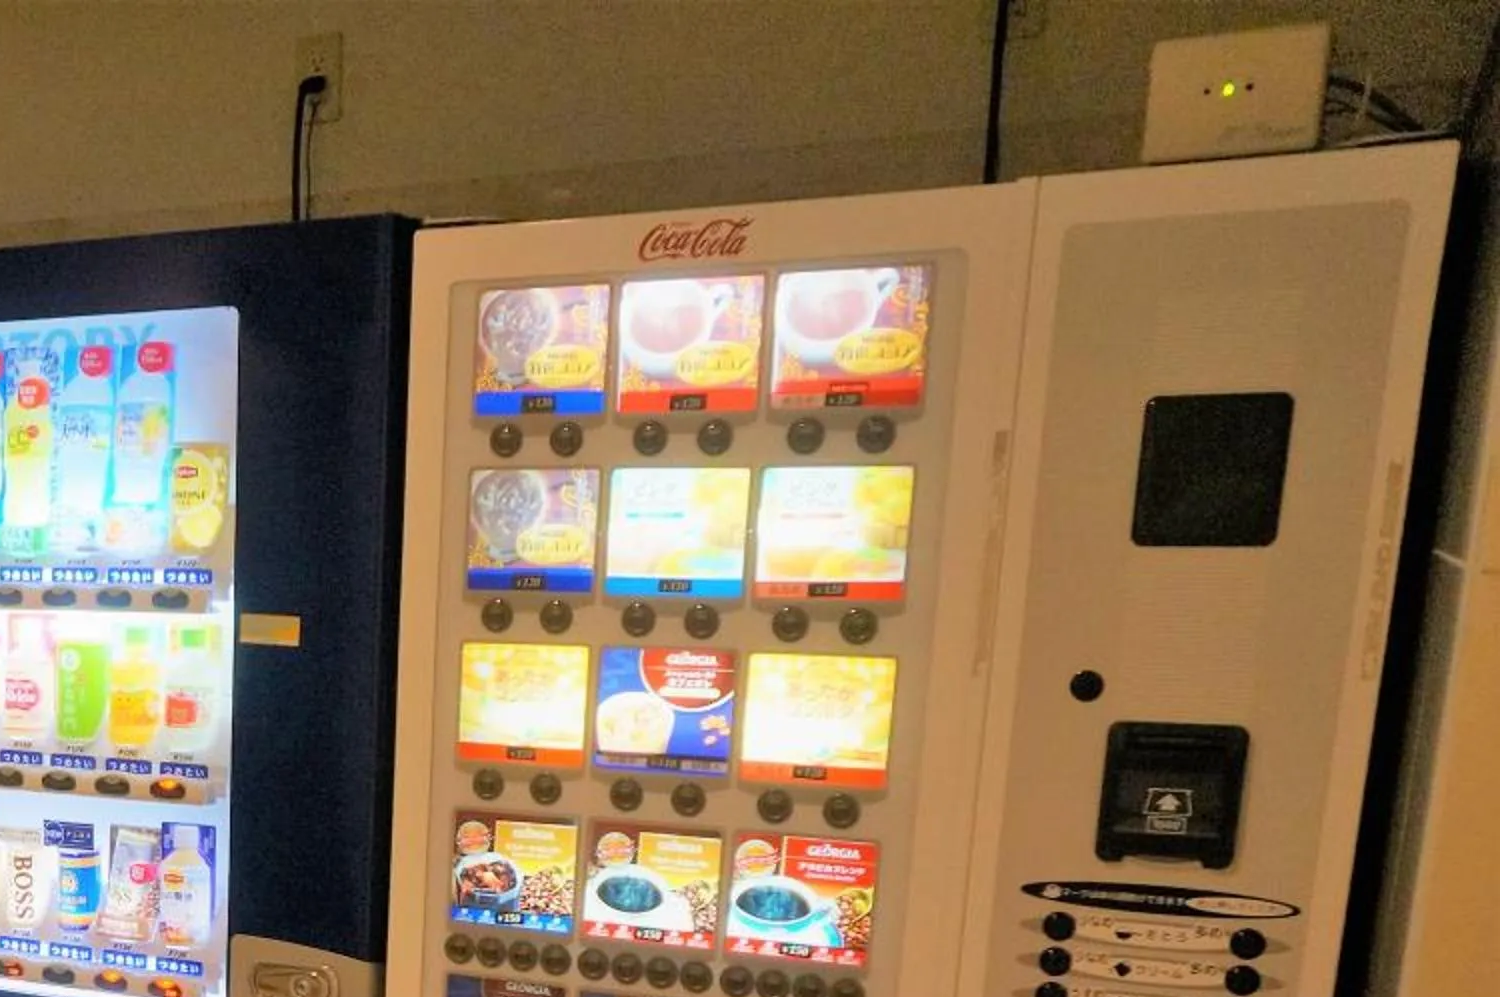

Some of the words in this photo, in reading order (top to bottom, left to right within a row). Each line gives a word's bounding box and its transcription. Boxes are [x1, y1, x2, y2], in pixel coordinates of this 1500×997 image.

[639, 218, 755, 262] Coca-Cola
[805, 843, 861, 860] GEORGIA
[13, 855, 35, 920] BOSS
